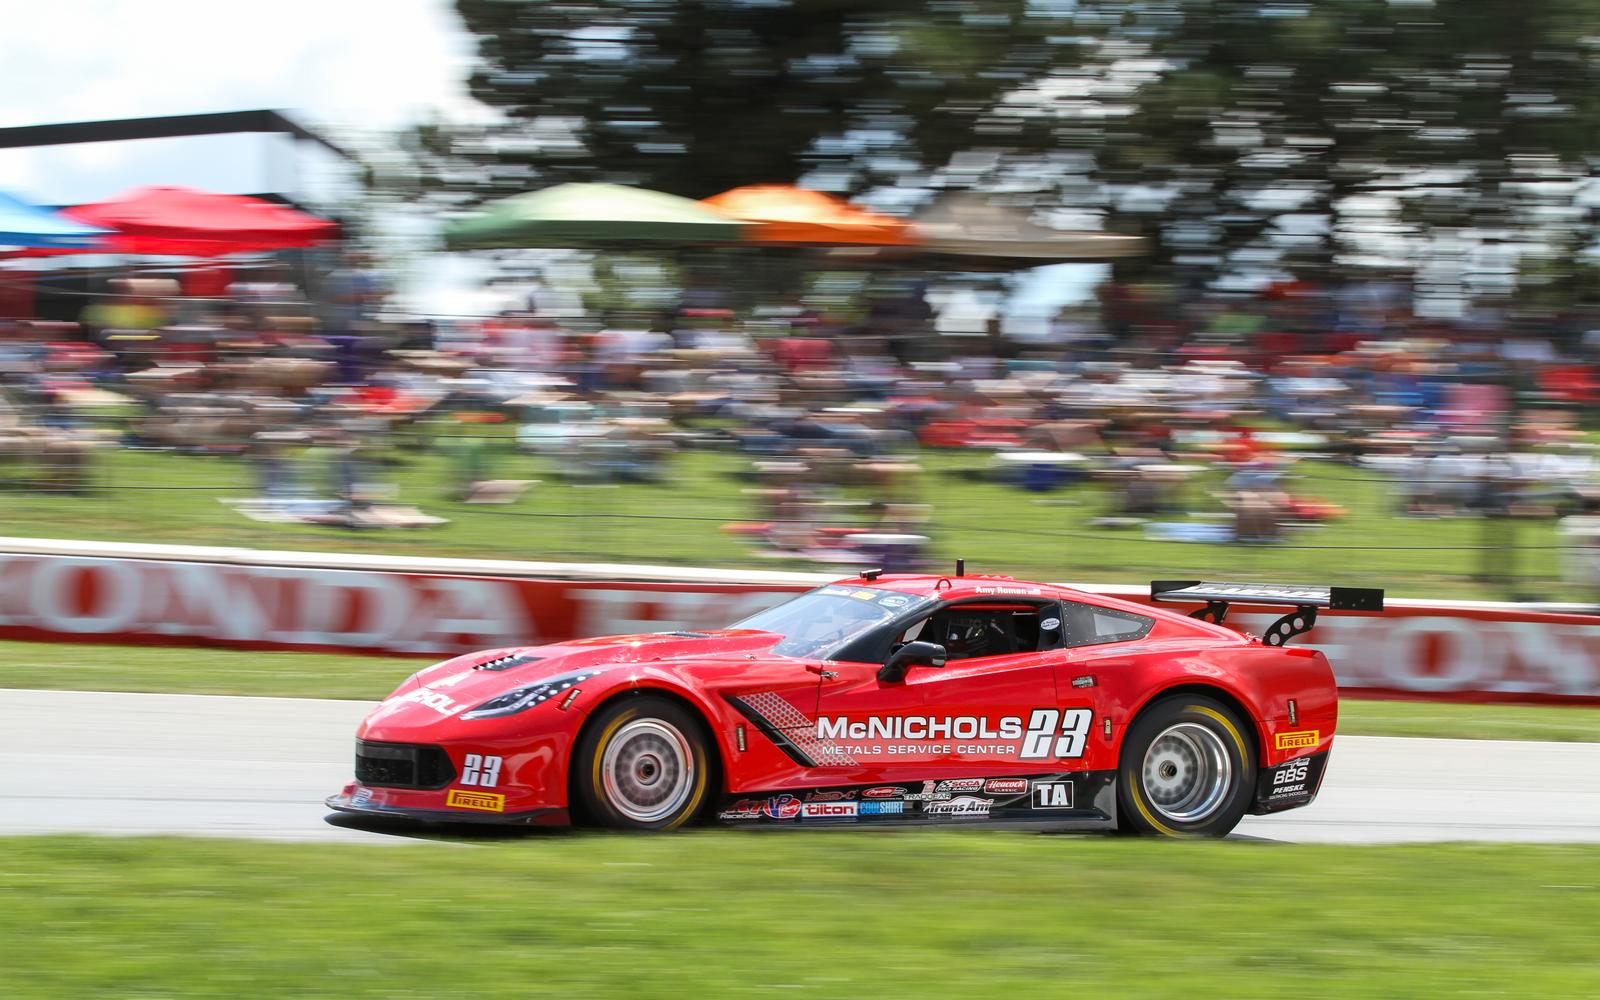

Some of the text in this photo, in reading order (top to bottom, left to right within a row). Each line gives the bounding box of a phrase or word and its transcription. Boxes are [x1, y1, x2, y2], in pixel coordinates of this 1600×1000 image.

[975, 586, 994, 595] Amy
[817, 716, 1022, 740] McNICHOLS
[1019, 708, 1092, 758] 23
[1279, 732, 1316, 748] PIRELLI
[822, 744, 1015, 755] METALS SERVICE CENTER
[460, 753, 503, 788] 23
[1273, 766, 1308, 785] BBS
[951, 779, 981, 787] SCCA
[988, 779, 1025, 788] Heacock
[1273, 783, 1305, 794] PENSKE
[452, 791, 499, 810] PIRELLI
[1037, 783, 1069, 806] TA
[806, 803, 854, 816] tilton
[926, 800, 989, 813] Trans Am
